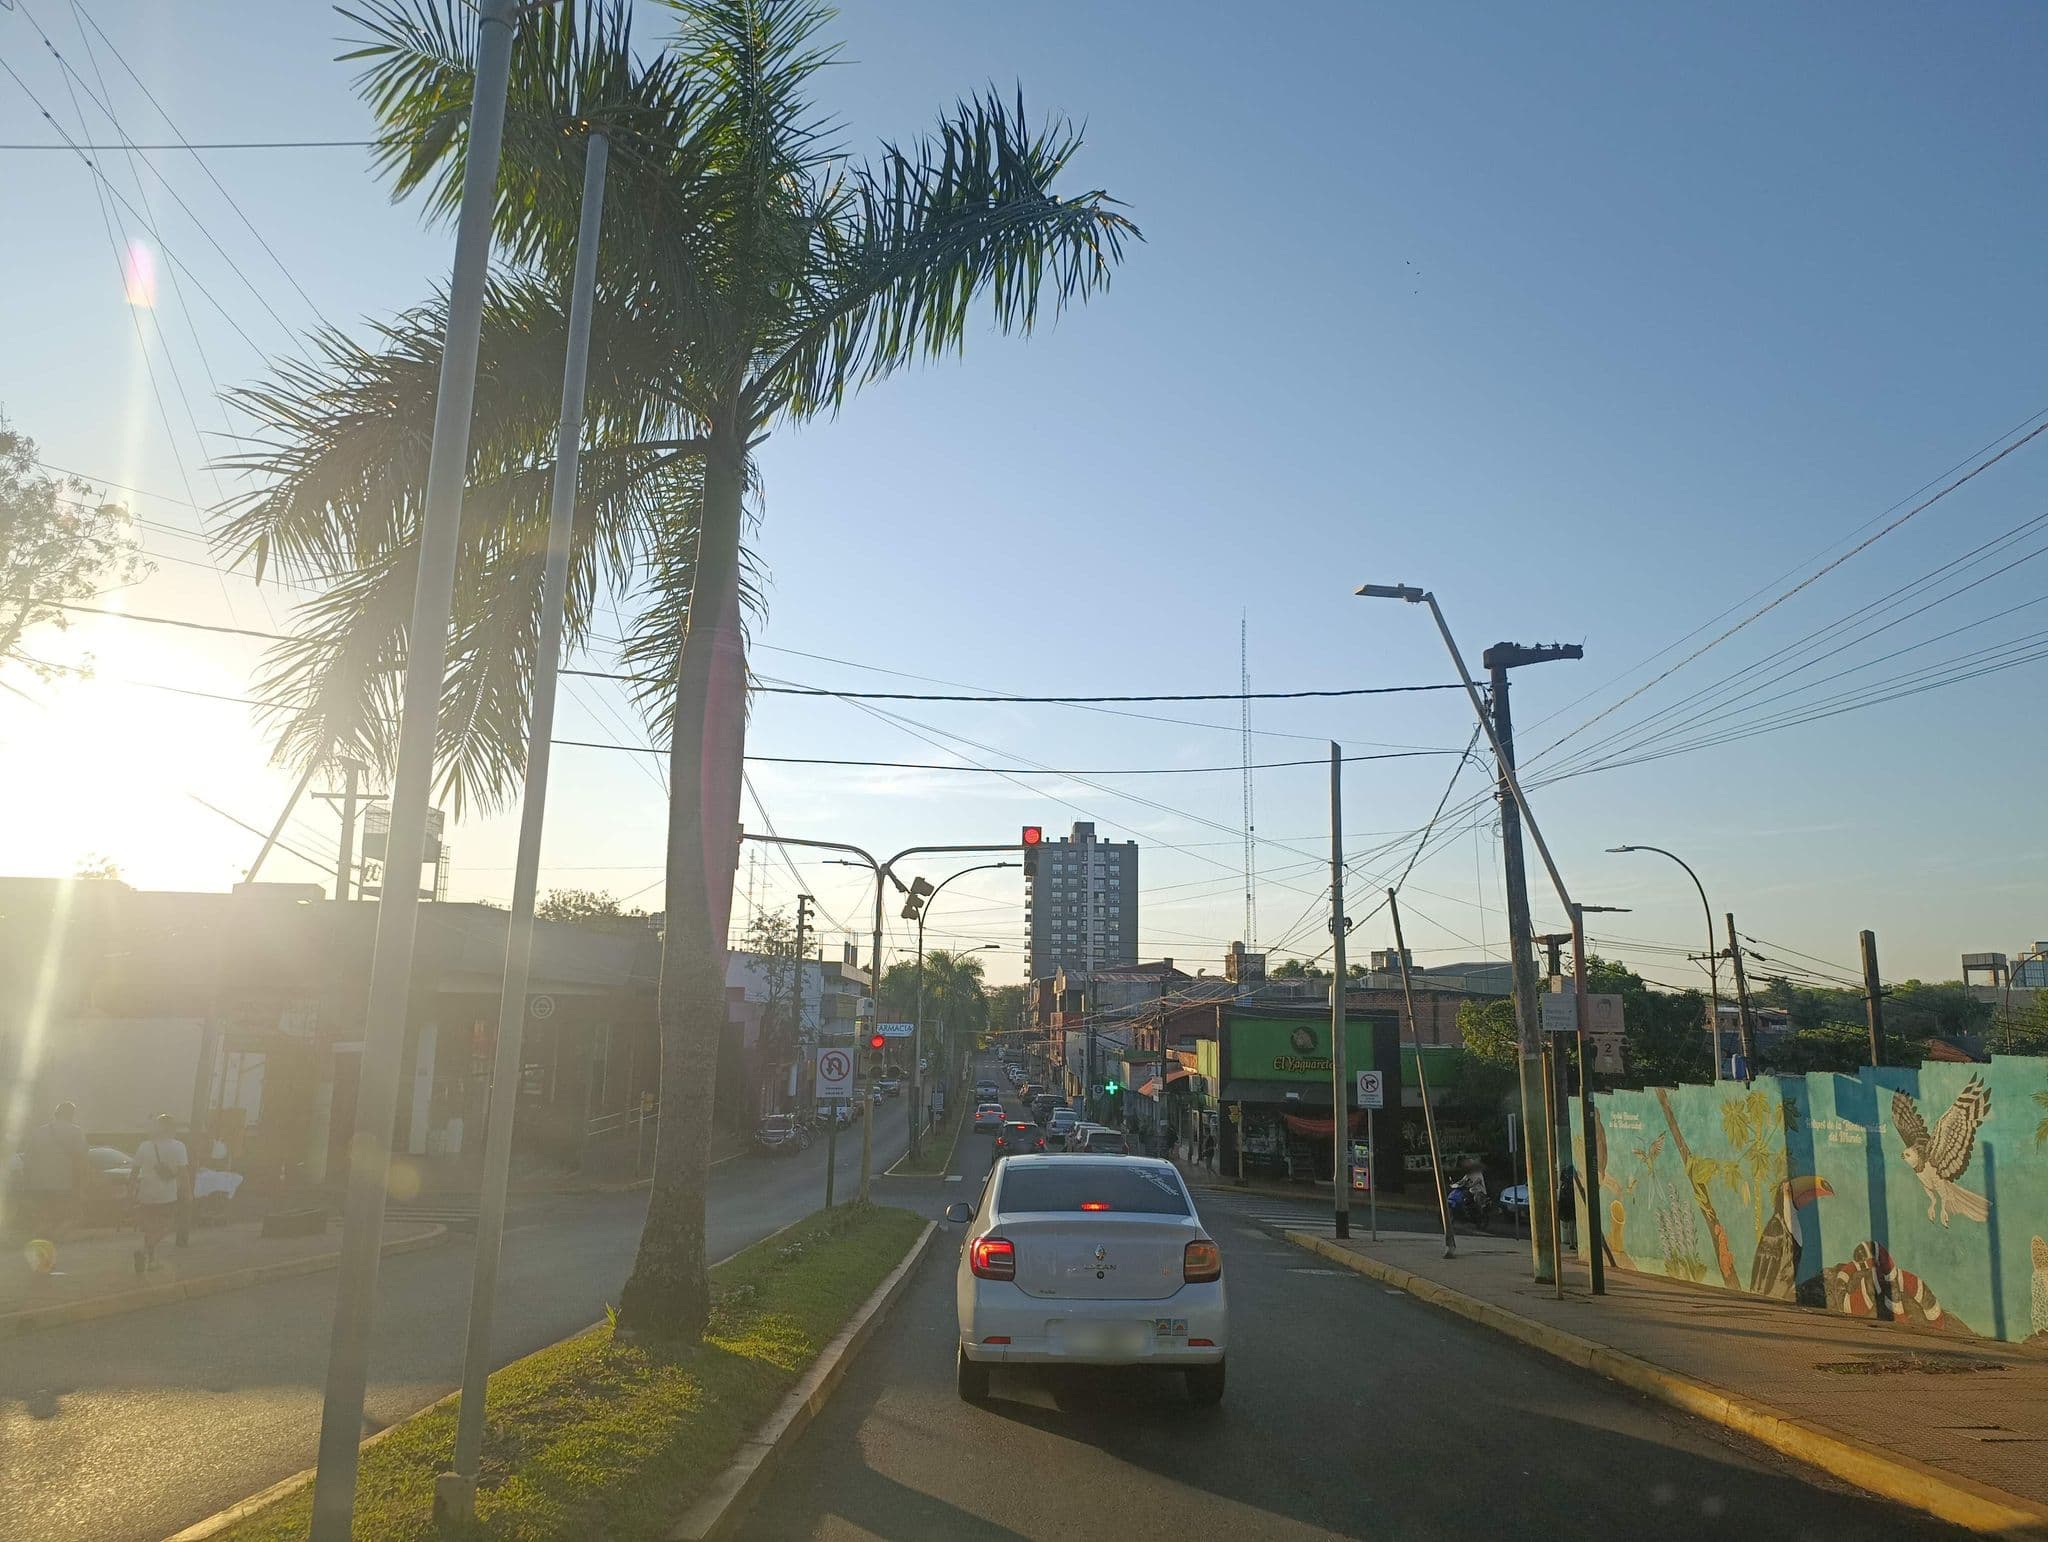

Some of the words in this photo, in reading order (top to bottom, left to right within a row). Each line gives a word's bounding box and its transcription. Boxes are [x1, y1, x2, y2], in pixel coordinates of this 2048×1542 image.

[876, 1023, 914, 1032] ARMACIA
[1605, 1043, 1611, 1053] 2
[1273, 1056, 1285, 1070] El
